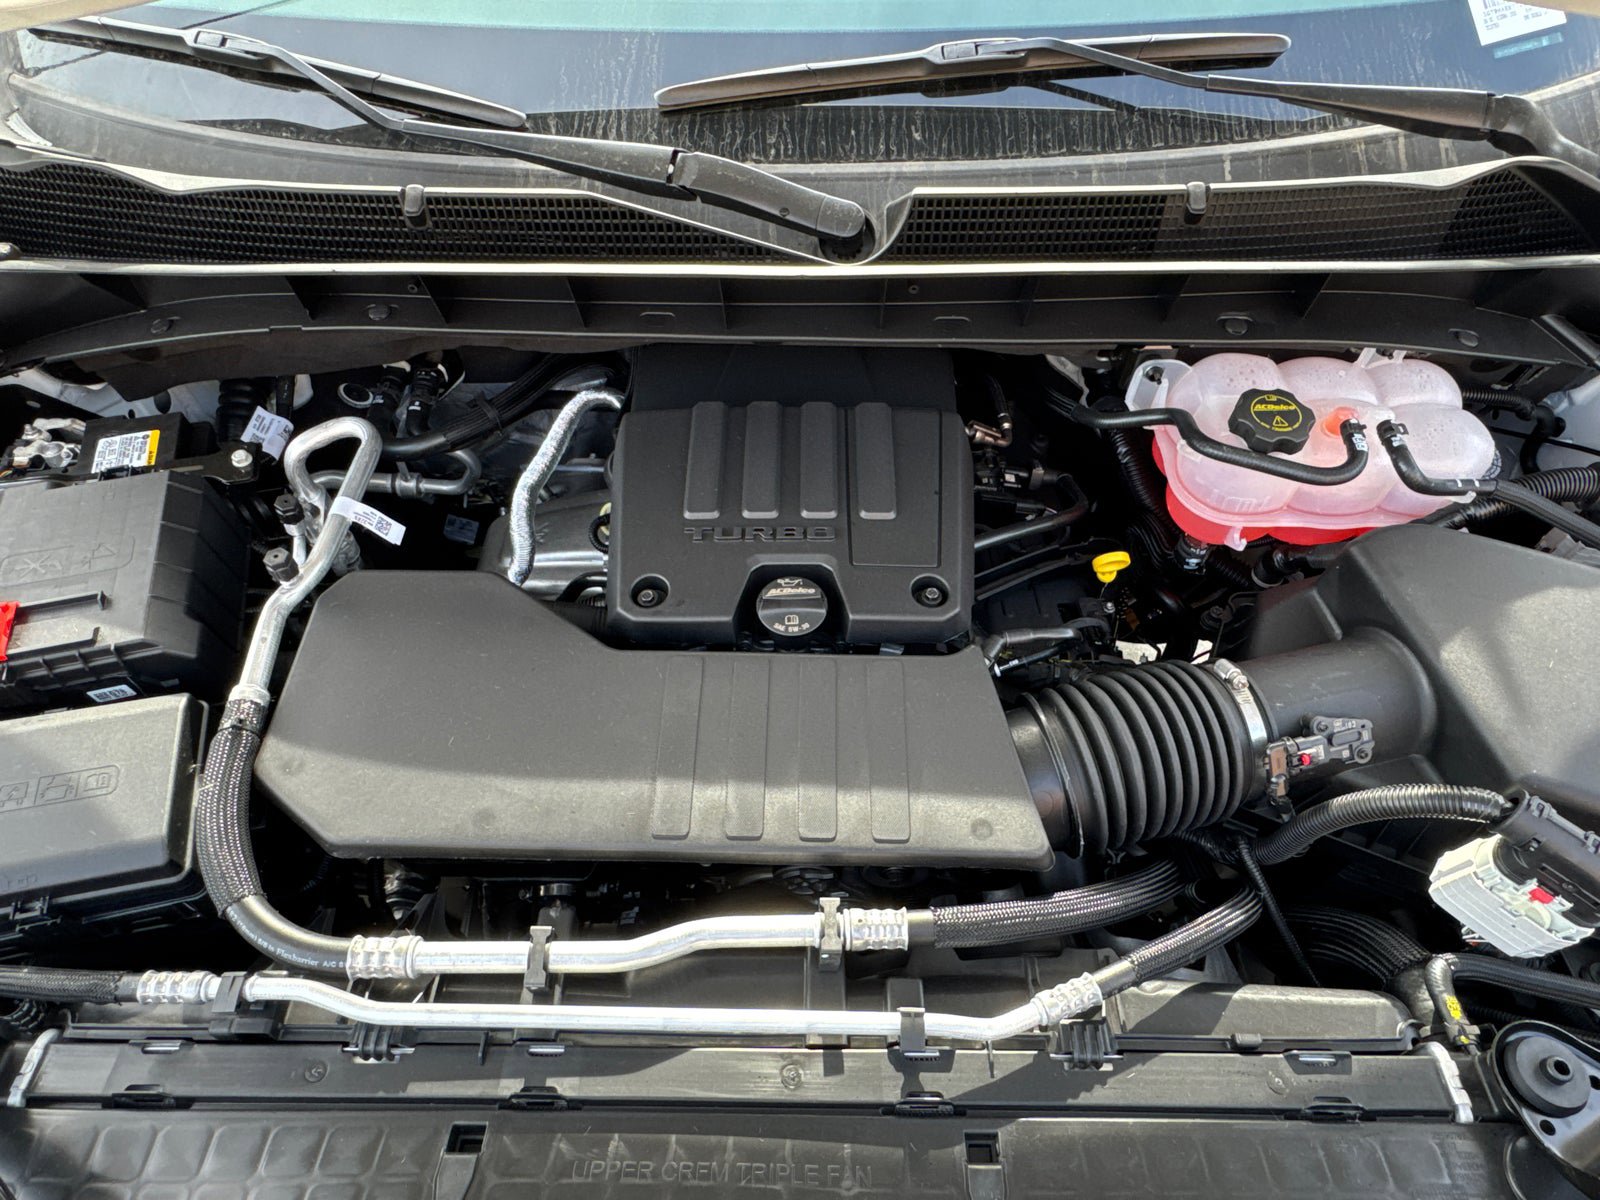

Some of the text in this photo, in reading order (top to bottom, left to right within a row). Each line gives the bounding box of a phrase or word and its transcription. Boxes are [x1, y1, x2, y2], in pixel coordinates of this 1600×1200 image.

[684, 527, 835, 543] TURBO
[765, 587, 816, 597] ACDelco
[276, 947, 319, 967] Flexbarrier
[572, 1160, 653, 1182] UPPER
[737, 1162, 819, 1186] TRIPLE
[827, 1164, 873, 1188] FAN
